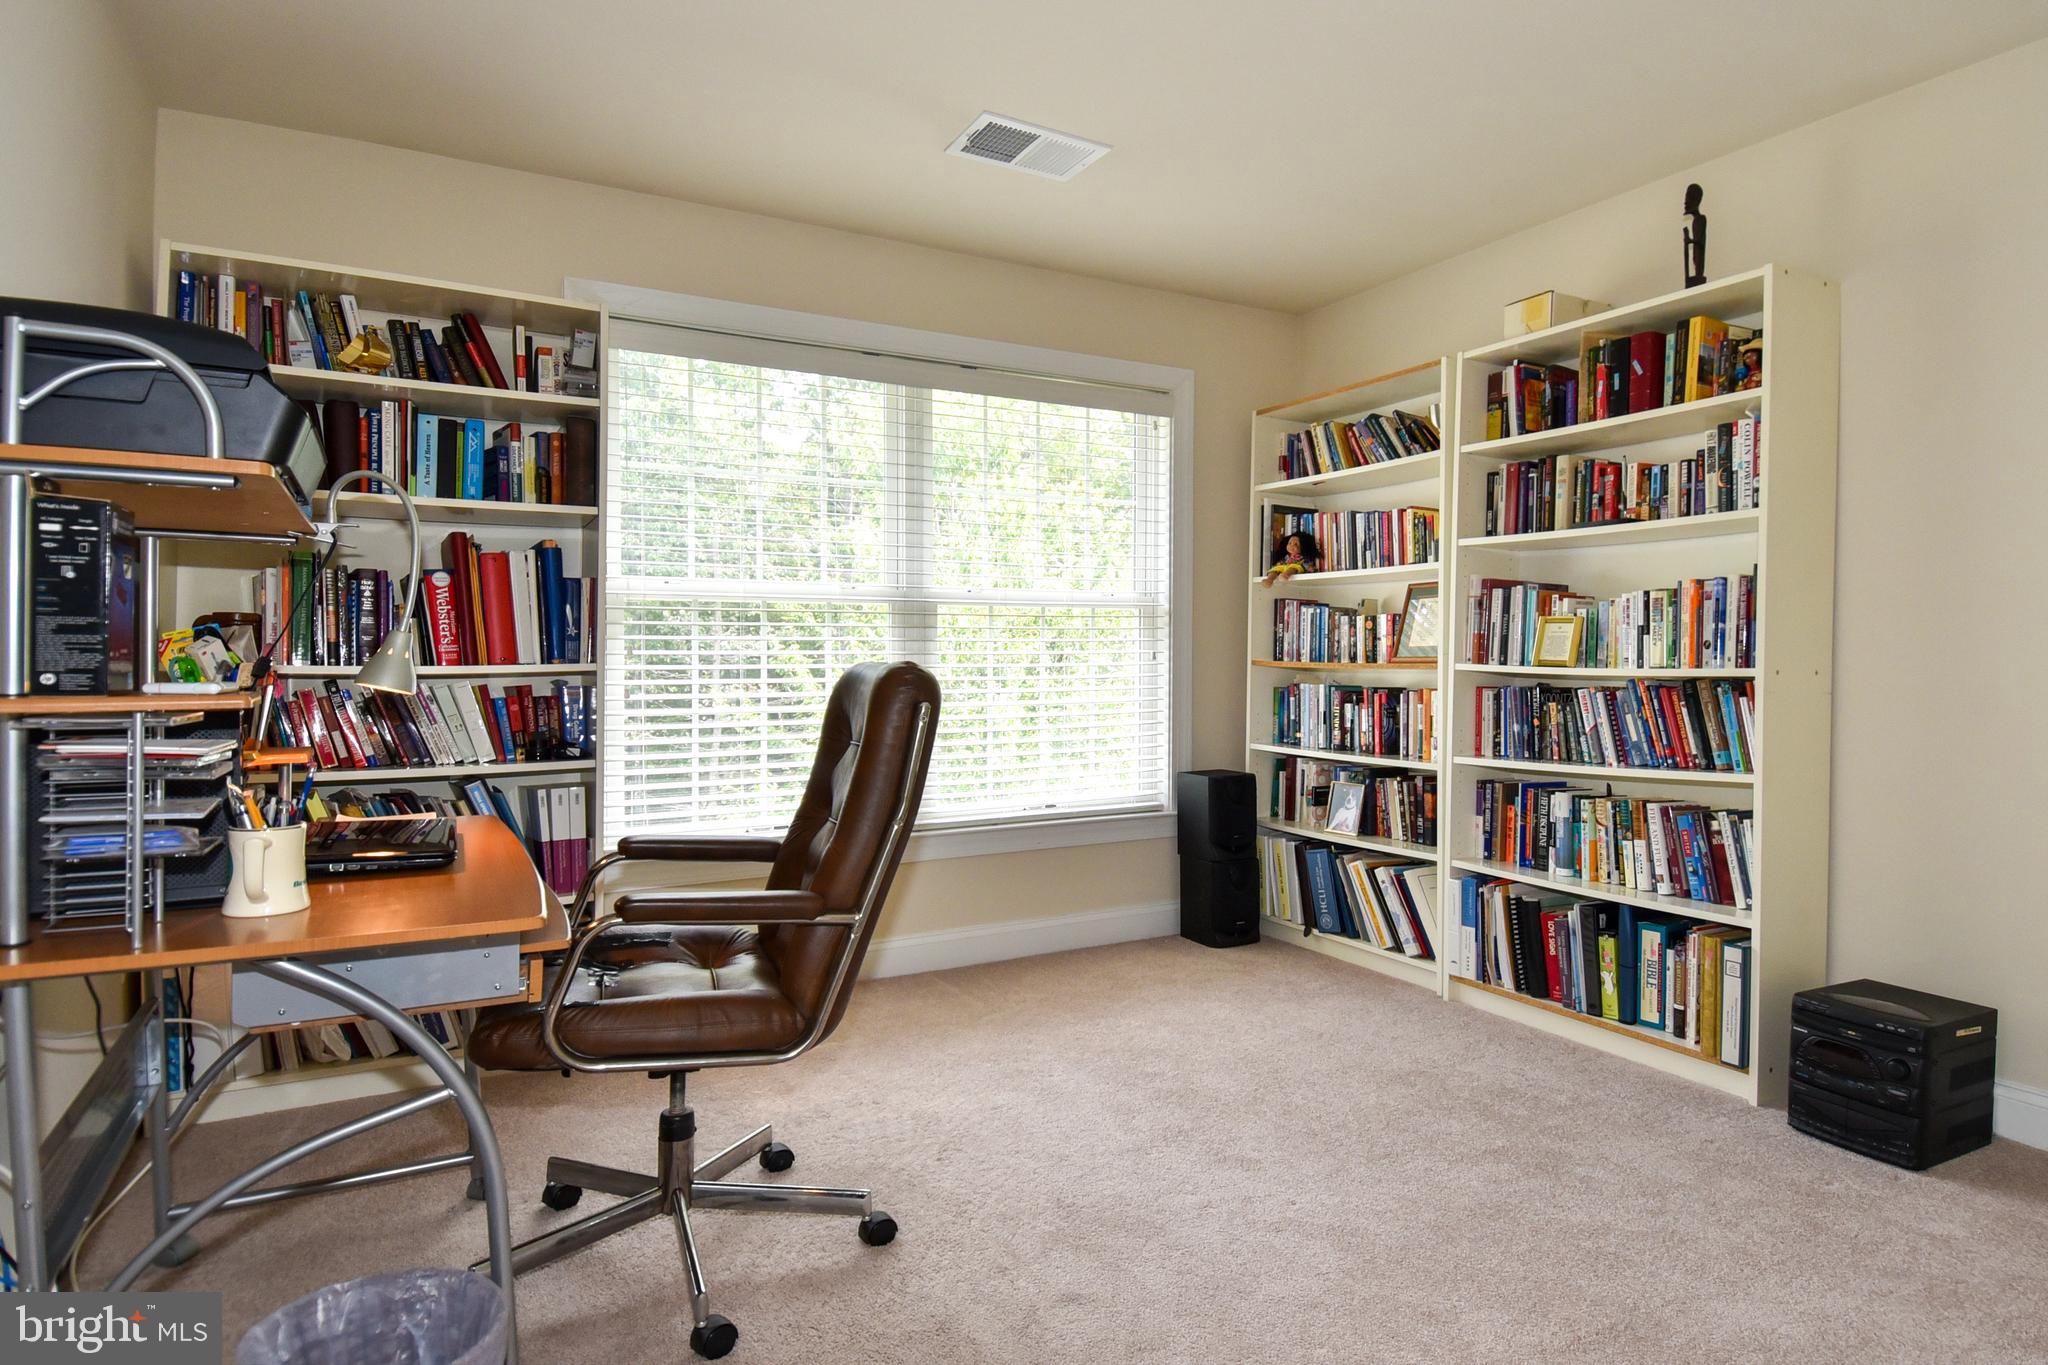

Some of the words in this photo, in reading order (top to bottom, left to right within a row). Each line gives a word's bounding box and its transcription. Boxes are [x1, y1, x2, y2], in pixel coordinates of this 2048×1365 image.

[1743, 423, 1751, 455] COLIN
[1743, 460, 1752, 501] POWELL
[435, 587, 455, 644] Webster's
[1540, 693, 1574, 703] KOONTZ
[571, 704, 579, 720] Drug
[1672, 694, 1680, 713] OFFICE
[1676, 714, 1686, 738] CLUTTER
[1540, 796, 1548, 814] FIFTH
[1648, 808, 1657, 825] FIRE
[1539, 814, 1548, 847] DISCIPLINE
[1651, 827, 1659, 846] AND
[1682, 831, 1690, 854] SWITCH
[1655, 848, 1663, 868] FURY
[1317, 890, 1329, 913] HCLI
[1547, 920, 1555, 937] LOVE
[1548, 937, 1556, 956] SIGNS
[1646, 958, 1657, 990] BIBLE
